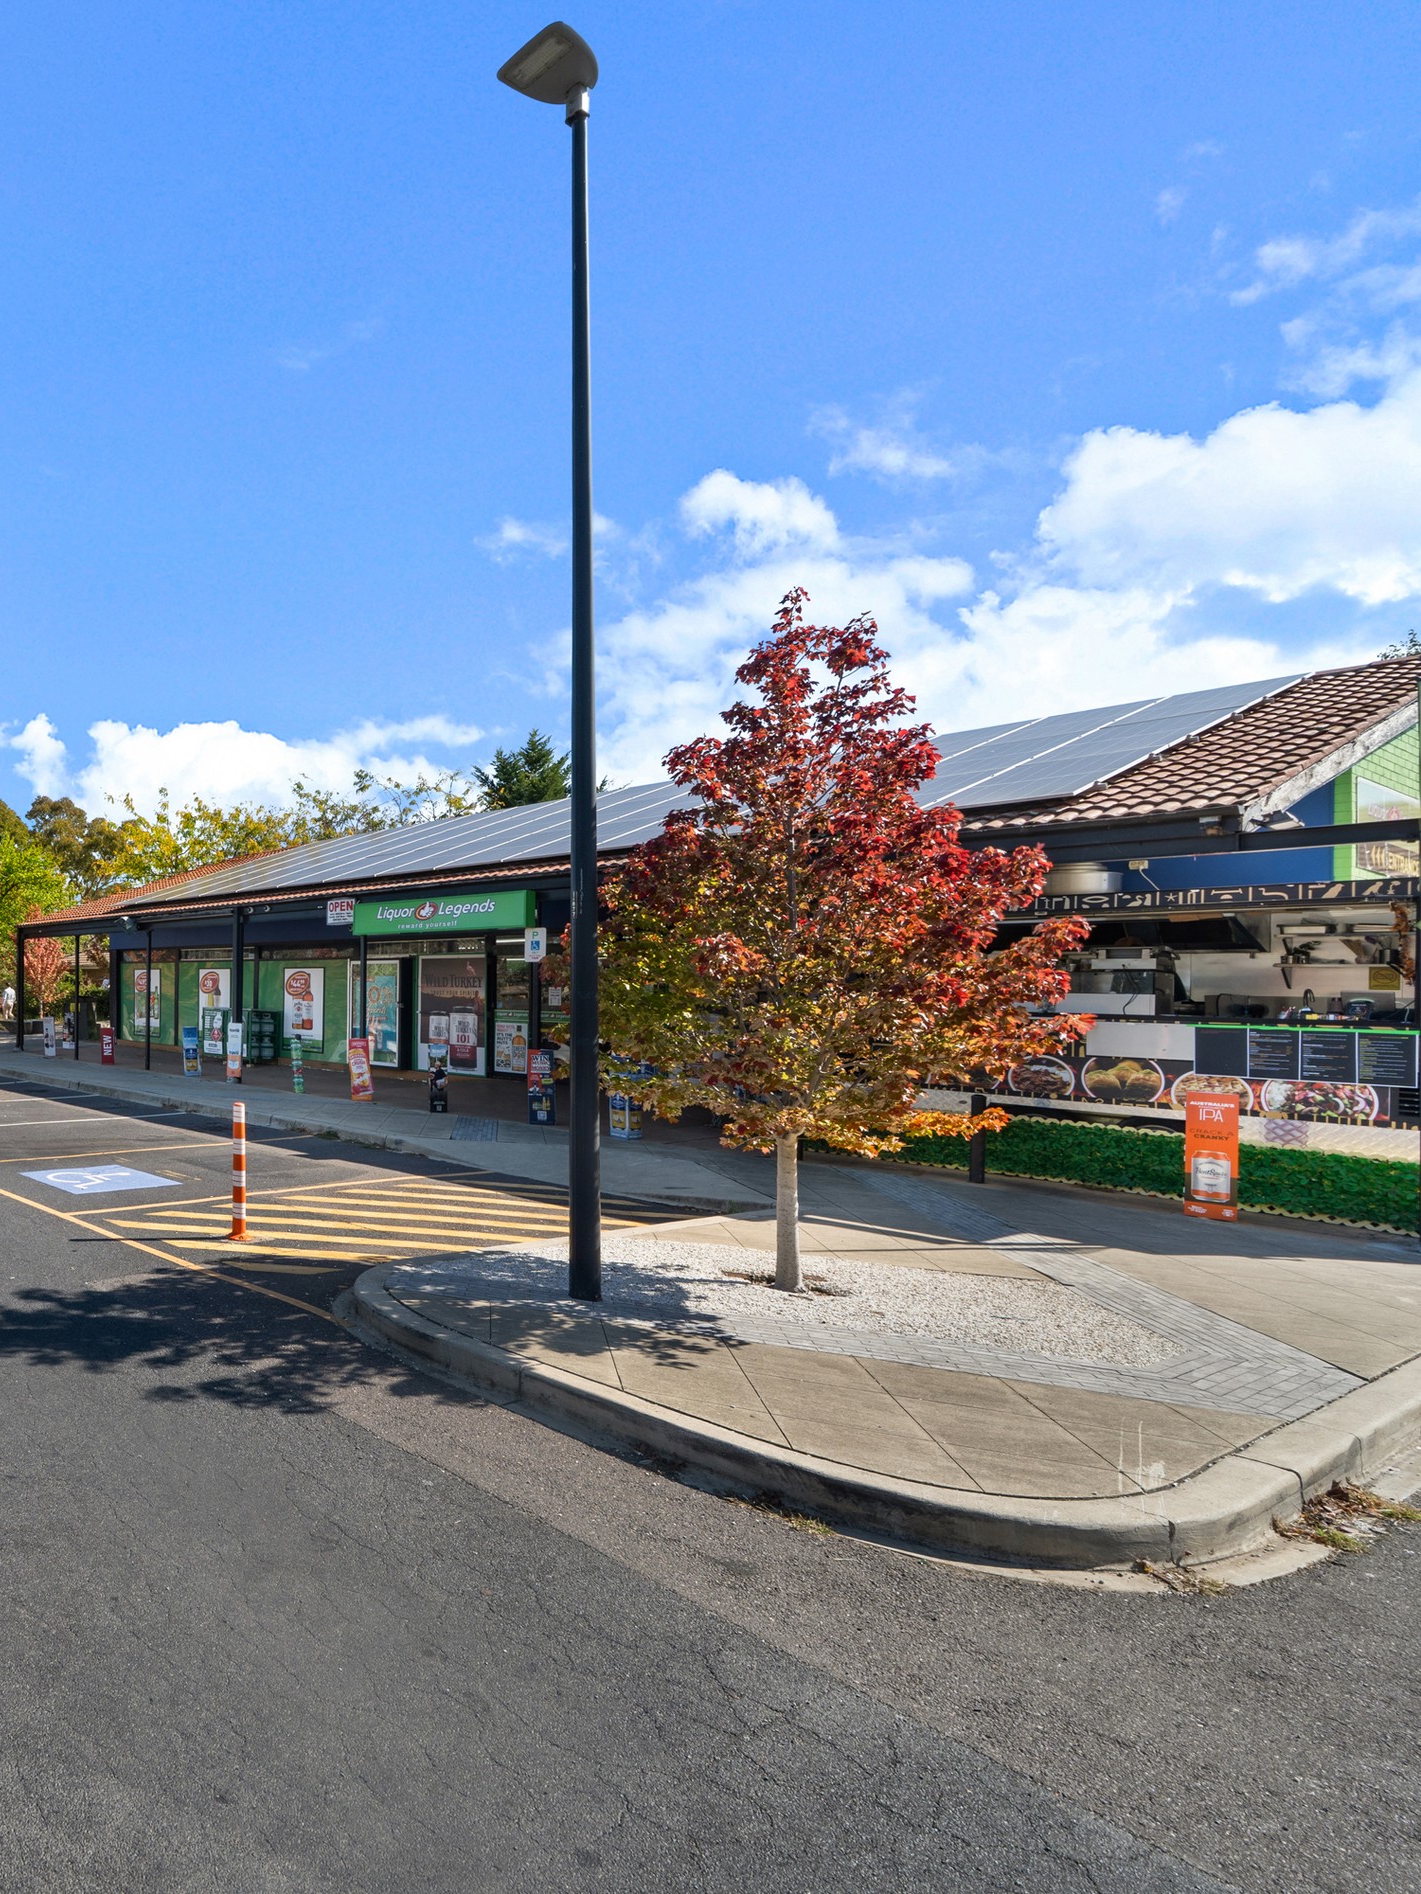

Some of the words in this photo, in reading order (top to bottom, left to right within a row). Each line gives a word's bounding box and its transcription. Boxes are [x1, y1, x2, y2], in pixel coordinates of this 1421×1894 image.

[329, 900, 353, 912] OPEN
[376, 906, 414, 922] Liquor
[438, 899, 495, 915] Legends
[425, 920, 458, 928] yourself
[532, 931, 539, 940] P
[425, 975, 449, 988] WILD
[450, 975, 483, 989] TURKEY
[103, 1035, 113, 1056] NEW
[456, 1035, 470, 1044] 101
[1199, 1108, 1223, 1122] IPA
